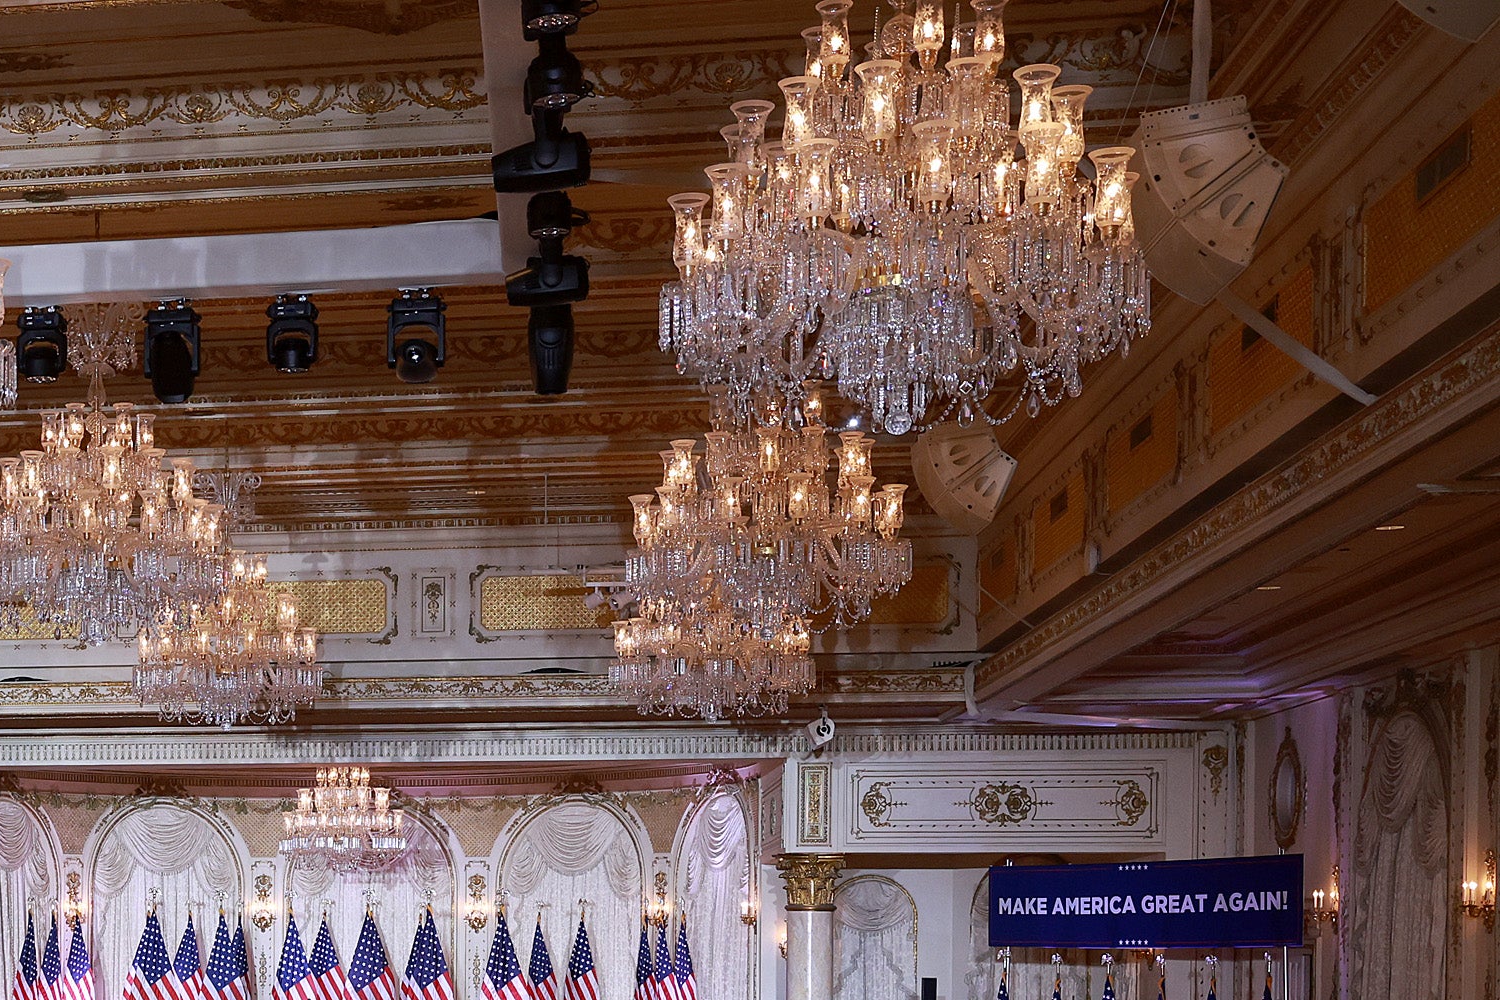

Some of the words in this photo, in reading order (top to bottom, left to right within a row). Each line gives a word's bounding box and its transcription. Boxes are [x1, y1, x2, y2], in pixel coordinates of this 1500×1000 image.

[998, 897, 1047, 915] MAKE
[1052, 895, 1137, 915] AMERICA
[1141, 894, 1208, 914] GREAT
[1212, 890, 1288, 912] AGAIN!
